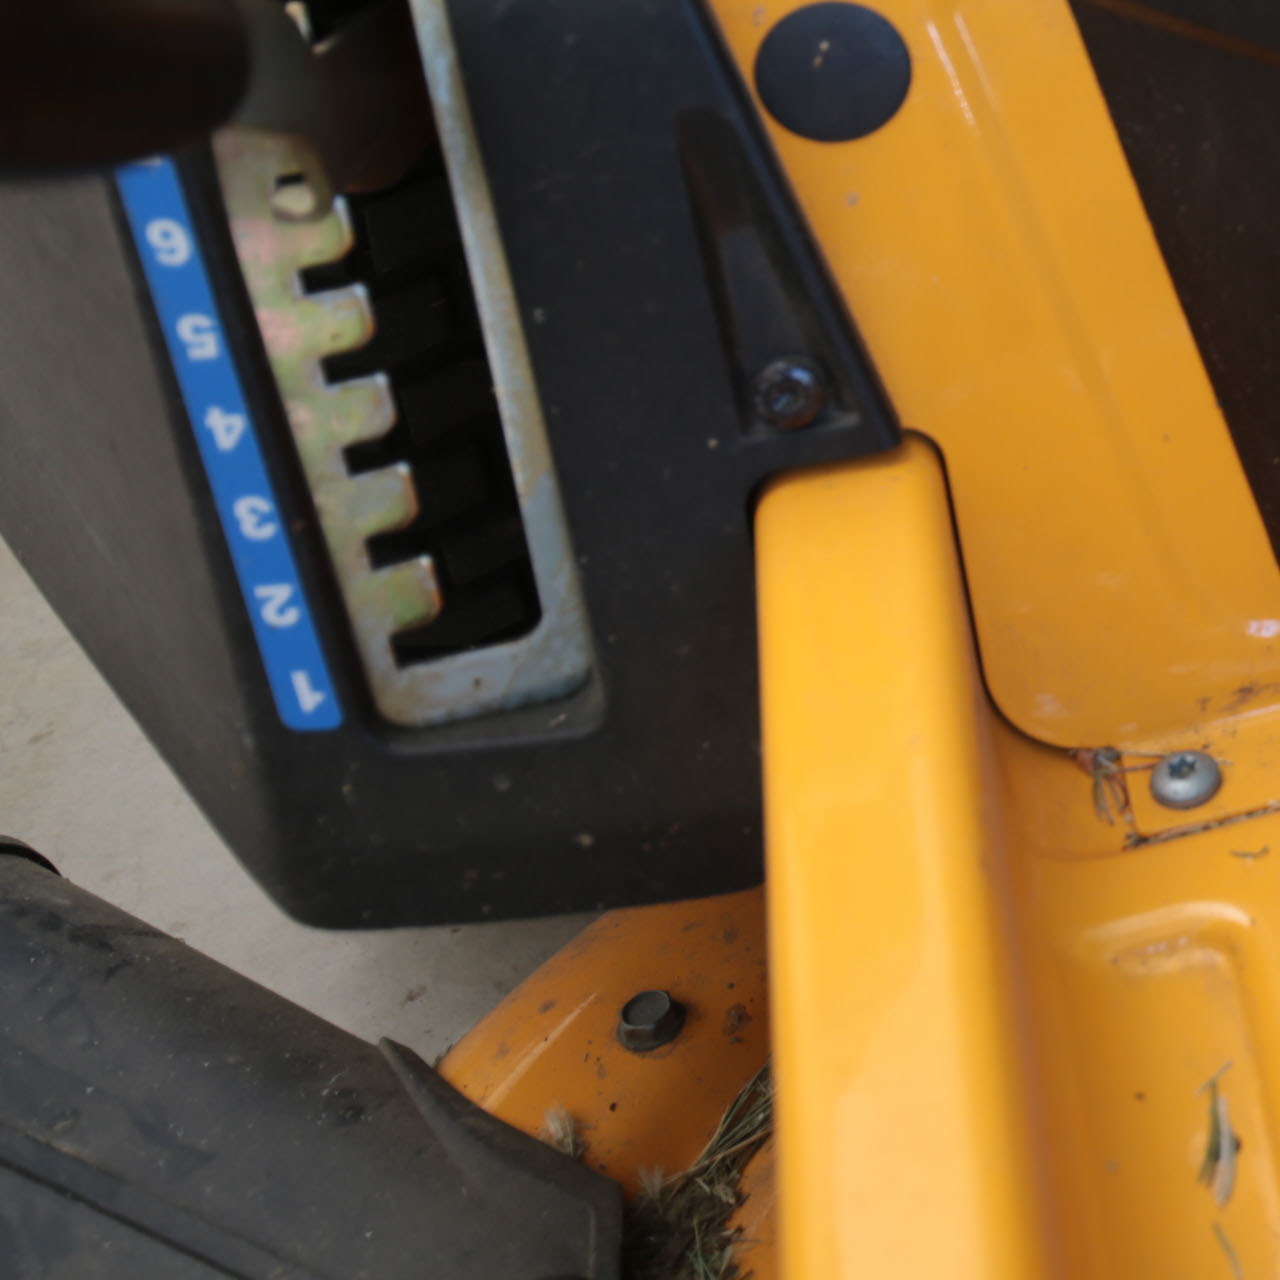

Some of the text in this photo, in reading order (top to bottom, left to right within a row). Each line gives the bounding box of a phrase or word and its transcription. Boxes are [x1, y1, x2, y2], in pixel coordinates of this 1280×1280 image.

[144, 218, 193, 267] 6
[175, 313, 220, 361] 5
[204, 406, 247, 452] 4
[233, 495, 277, 541] 3
[253, 583, 300, 628] 2
[291, 670, 325, 713] 1
